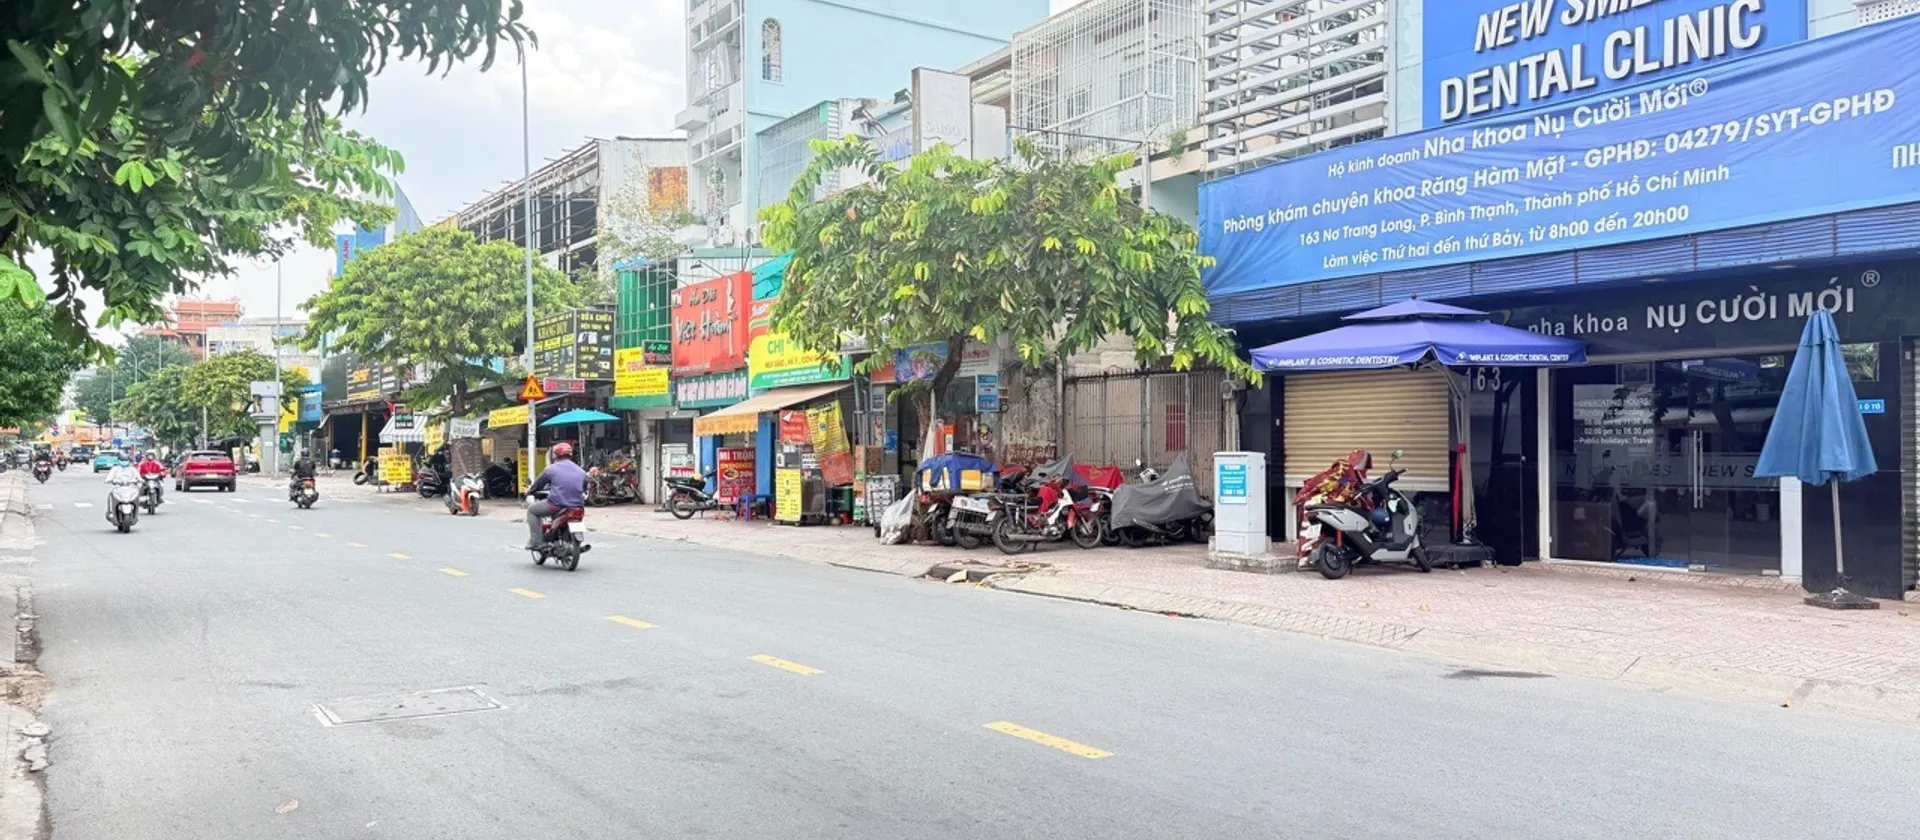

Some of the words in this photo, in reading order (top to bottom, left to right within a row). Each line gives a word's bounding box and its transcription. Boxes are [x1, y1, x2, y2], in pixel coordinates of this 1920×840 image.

[1474, 0, 1554, 52] NEW
[1440, 43, 1597, 121] DENTAL
[1603, 0, 1763, 80] CLINIC
[1223, 213, 1265, 235] Phòng
[1267, 205, 1308, 226] khám
[1312, 190, 1369, 216] chuyên
[1374, 184, 1416, 203] khoa
[1421, 174, 1469, 197] Răng
[1474, 165, 1519, 188] Hàm
[1525, 156, 1565, 181] Mặt
[1583, 139, 1657, 168] GPHĐ:
[1664, 88, 1896, 154] 04279/SYT-GPHĐ
[1328, 162, 1346, 179] Hộ
[1348, 156, 1374, 174] kinh
[1378, 149, 1420, 168] doanh
[1424, 135, 1465, 159] Nha
[1472, 123, 1527, 149] khoa
[1533, 113, 1566, 140] Nụ
[1572, 98, 1631, 129] Cười
[1299, 231, 1320, 246] 163
[1323, 228, 1340, 243] Nơ
[1342, 223, 1377, 239] Trang
[1381, 215, 1416, 233] Long,
[1420, 213, 1431, 227] P.
[1436, 207, 1465, 226] Bình
[1469, 201, 1519, 220] Thạnh,
[1524, 192, 1573, 212] Thành
[1577, 179, 1612, 207] phố
[1616, 174, 1641, 197] Hồ
[1646, 169, 1678, 192] Chí
[1683, 164, 1729, 187] Minh
[1323, 253, 1349, 269] Làm
[1351, 249, 1378, 267] việc
[1382, 244, 1406, 261] Thứ
[1407, 241, 1429, 257] hai
[1433, 236, 1461, 254] đến
[1465, 231, 1489, 249] thứ
[1492, 228, 1524, 248] Bảy,
[1529, 224, 1546, 242] từ
[1549, 217, 1590, 239] 8h00
[1594, 211, 1628, 232] đến
[1632, 203, 1690, 229] 20h00
[1528, 317, 1566, 337] nha
[1573, 311, 1628, 335] khoa
[1647, 305, 1687, 334] NỤ
[1696, 285, 1777, 324] CƯỜI
[1788, 276, 1854, 318] MỚI
[1278, 357, 1309, 366] IMPLANT
[1317, 356, 1354, 365] COSMETIC
[1355, 355, 1400, 365] DENTISTRY
[1466, 366, 1501, 391] 163
